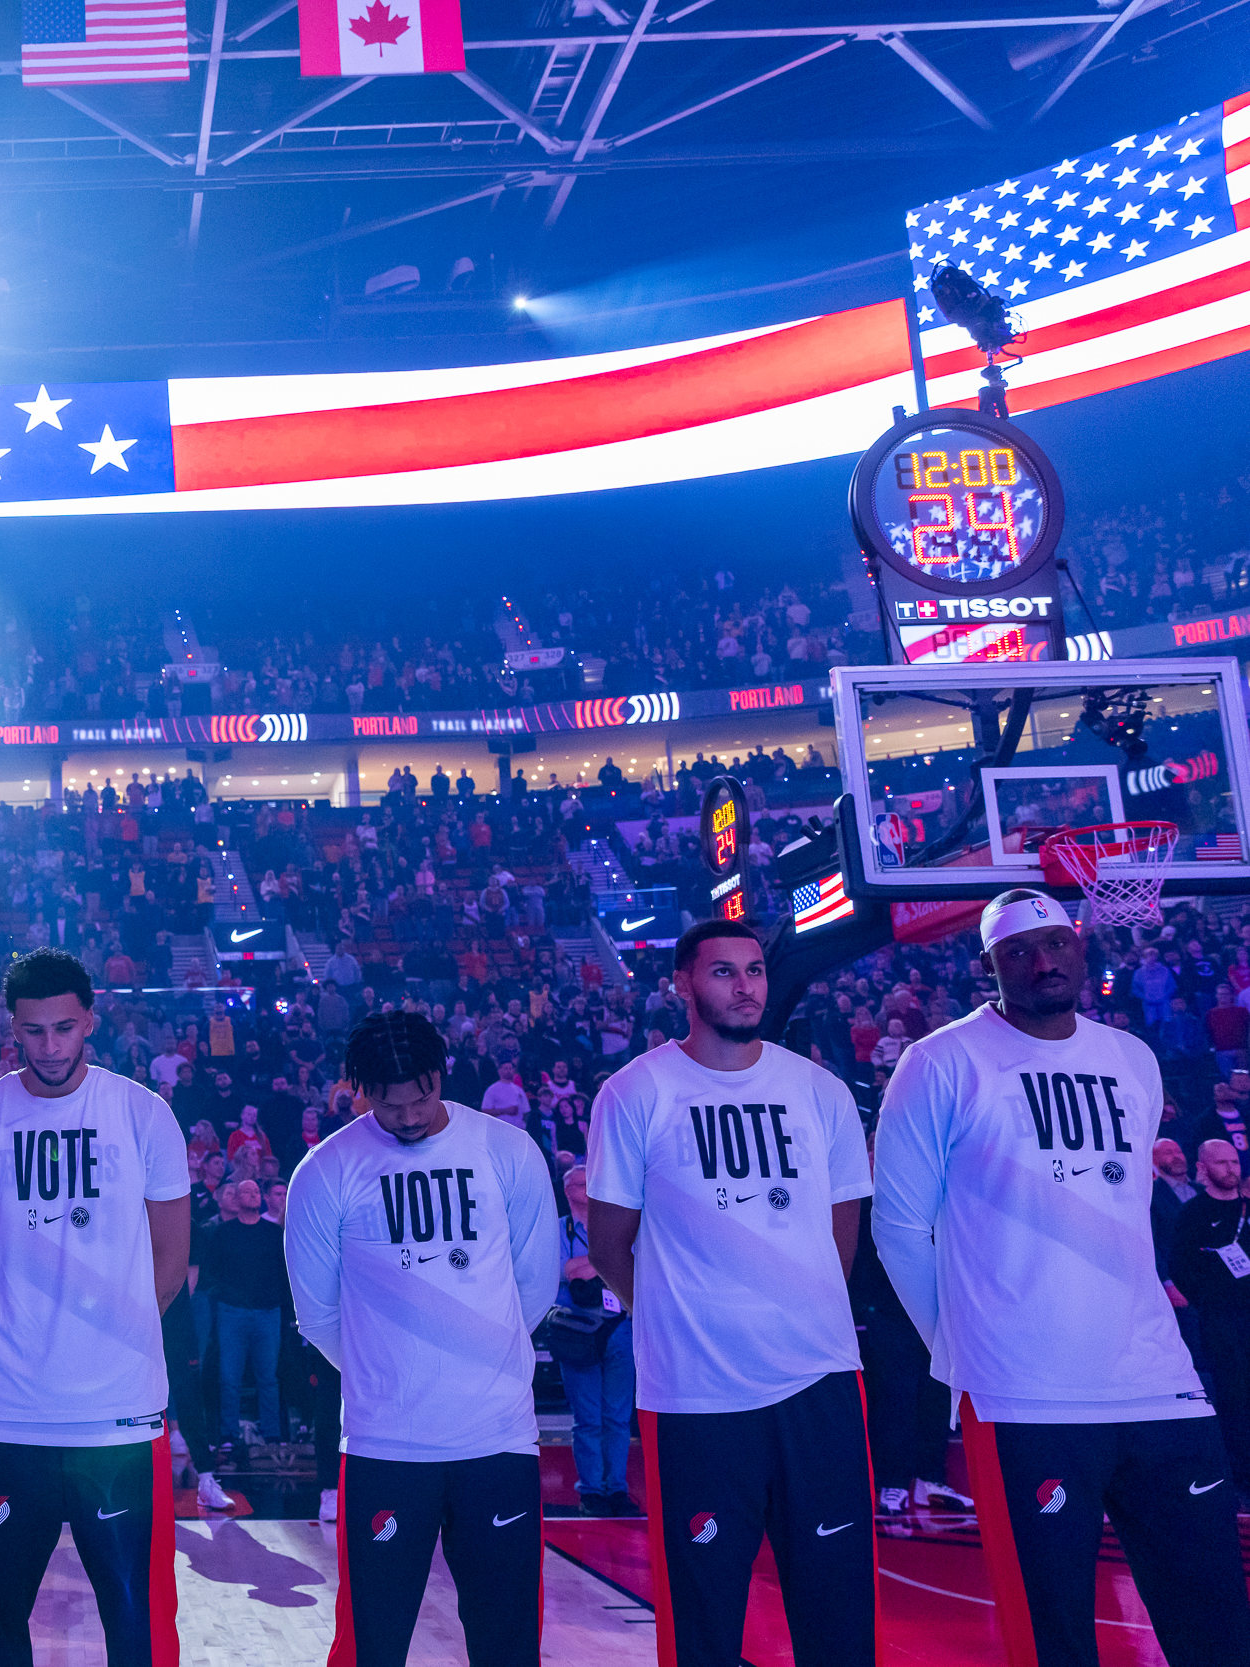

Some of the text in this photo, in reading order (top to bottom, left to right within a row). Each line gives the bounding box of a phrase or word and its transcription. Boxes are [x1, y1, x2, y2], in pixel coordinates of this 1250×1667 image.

[911, 449, 1016, 489] 12:00
[908, 491, 1018, 563] 24
[939, 597, 1052, 618] TISSOT
[1173, 615, 1250, 646] PORTLAN
[729, 685, 804, 711] PORTLAND
[352, 716, 418, 735] PORTLAND
[716, 828, 736, 865] 24
[1019, 1072, 1132, 1153] VOTE
[689, 1104, 798, 1179] VOTE
[14, 1128, 99, 1201] VOTE
[380, 1168, 478, 1244] VOTE
